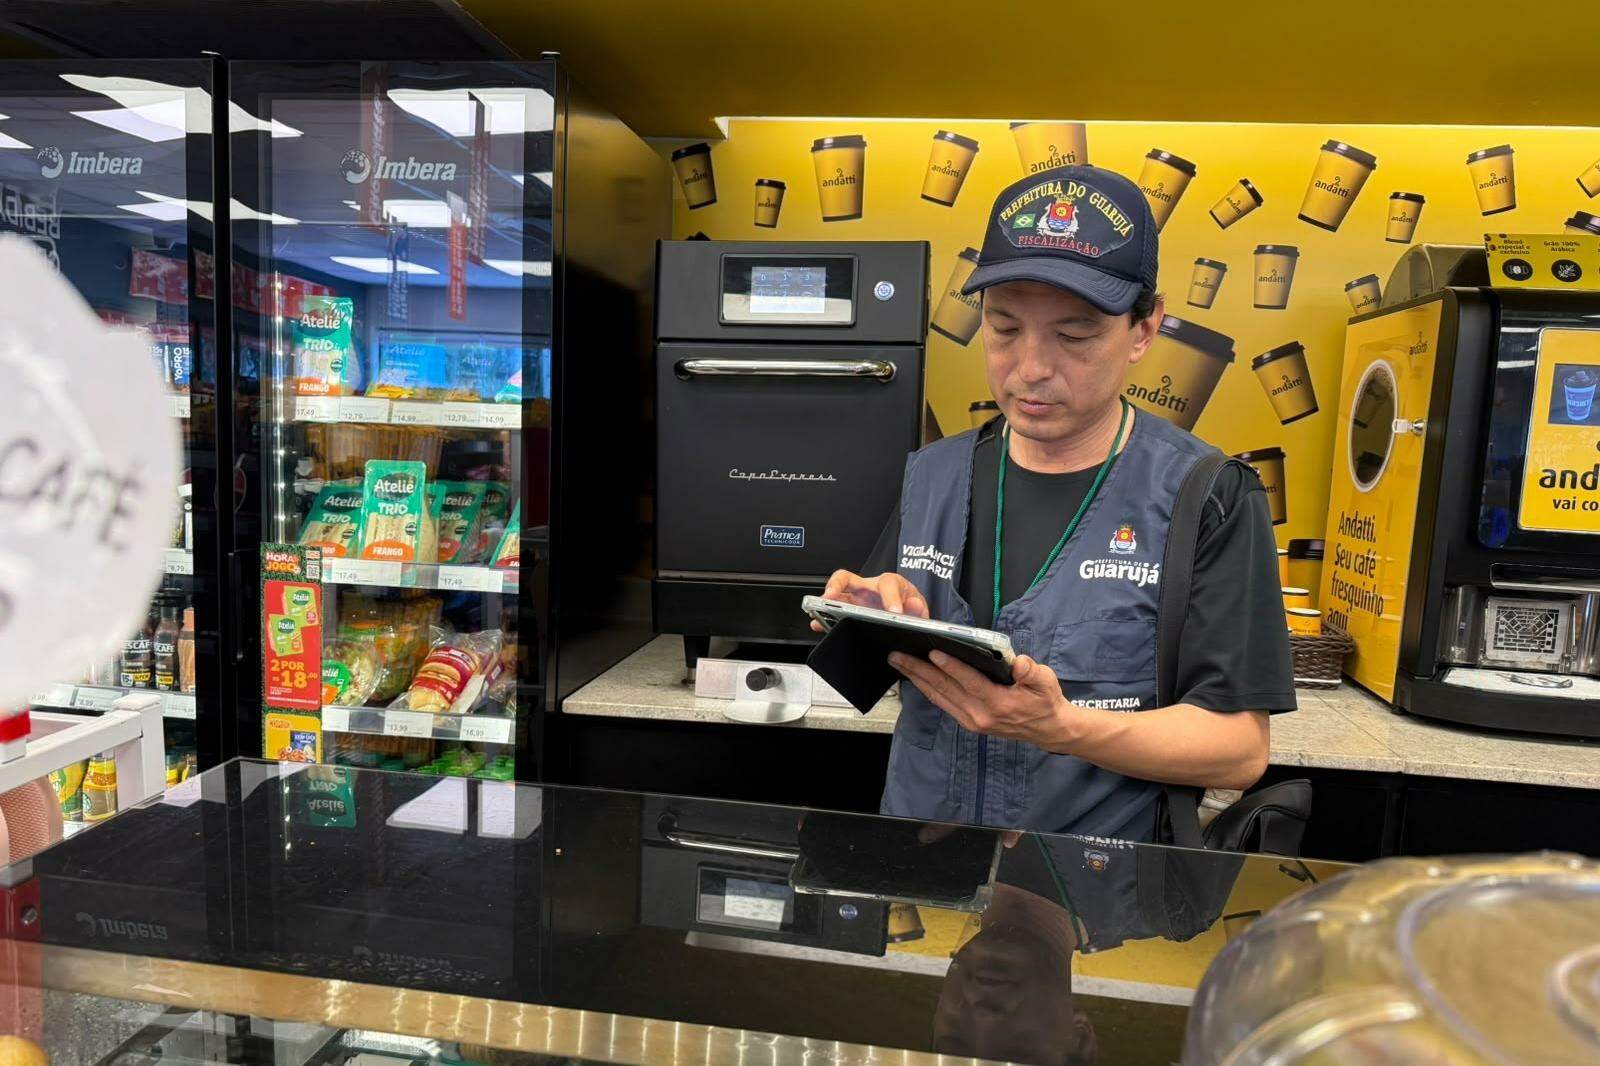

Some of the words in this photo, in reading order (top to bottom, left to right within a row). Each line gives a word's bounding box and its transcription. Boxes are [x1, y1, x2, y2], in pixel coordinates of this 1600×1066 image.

[67, 151, 144, 175] Imbera
[373, 156, 457, 181] Imbera
[930, 163, 961, 179] andatti
[1030, 150, 1077, 174] andatti
[684, 170, 709, 186] andatti
[822, 174, 857, 188] andatti
[1478, 174, 1510, 190] andatti
[1141, 184, 1174, 205] andatti
[1314, 178, 1351, 200] andatti
[1000, 180, 1063, 222] PREFEITURA
[1066, 180, 1087, 198] DO
[1089, 192, 1134, 238] GUARUJÁ
[1390, 214, 1413, 223] andatti
[1017, 234, 1100, 257] FISCALIZAÇÃO
[1258, 272, 1287, 284] andatti
[303, 337, 333, 351] TRIO
[298, 381, 331, 393] FRANGO
[1271, 376, 1305, 397] andatti
[1126, 383, 1190, 414] andatti
[373, 478, 416, 494] Atelié
[377, 501, 409, 515] TRIO
[1552, 496, 1577, 511] vai
[1581, 501, 1600, 511] co
[320, 512, 351, 523] TRIO
[1337, 510, 1377, 544] Andatti.
[372, 546, 404, 557] FRANGO
[1334, 542, 1351, 571] Seu
[1353, 548, 1377, 579] café
[900, 557, 954, 580] SANITÁRIA
[1079, 558, 1160, 588] Guarujá
[1331, 571, 1384, 618] fresquinho
[1326, 605, 1349, 631] aqui
[270, 659, 280, 671] 2
[281, 661, 305, 671] POR
[1071, 697, 1141, 709] SECRETARIA
